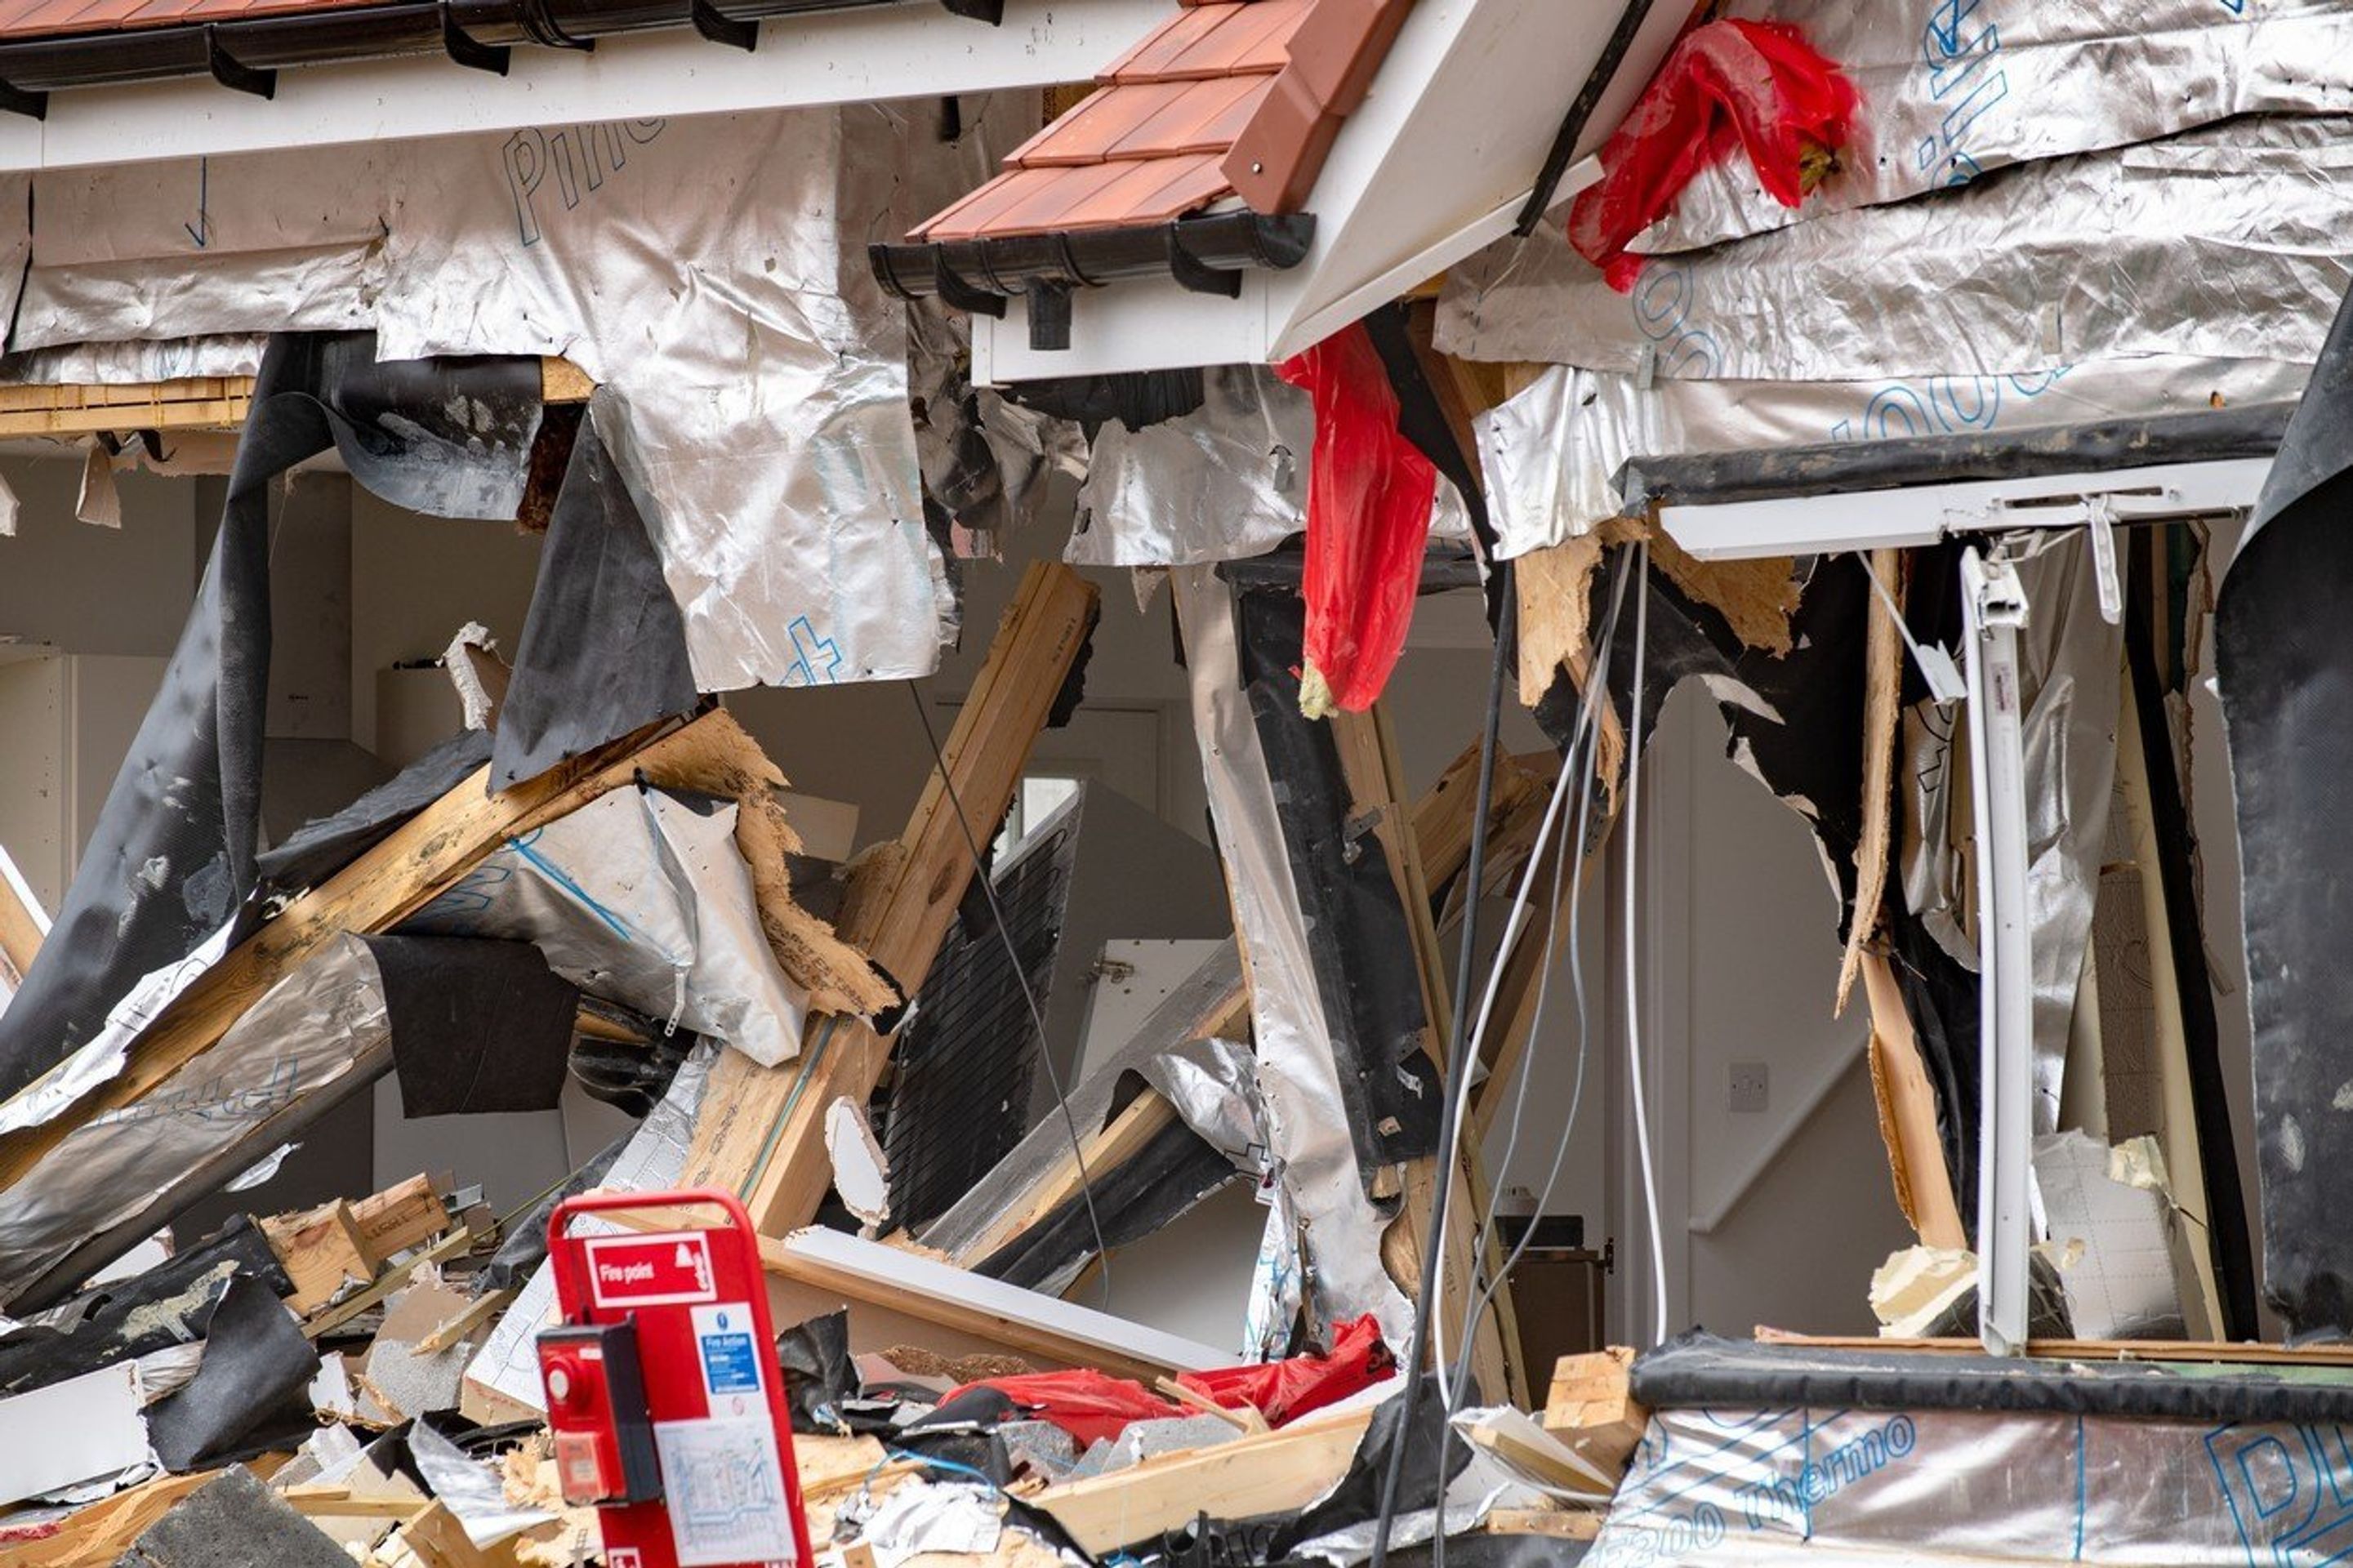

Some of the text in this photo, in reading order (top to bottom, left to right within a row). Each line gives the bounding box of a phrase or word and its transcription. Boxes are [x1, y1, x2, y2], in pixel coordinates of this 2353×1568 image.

[599, 1261, 654, 1285] Fire point
[1733, 1414, 1916, 1530] Thermo
